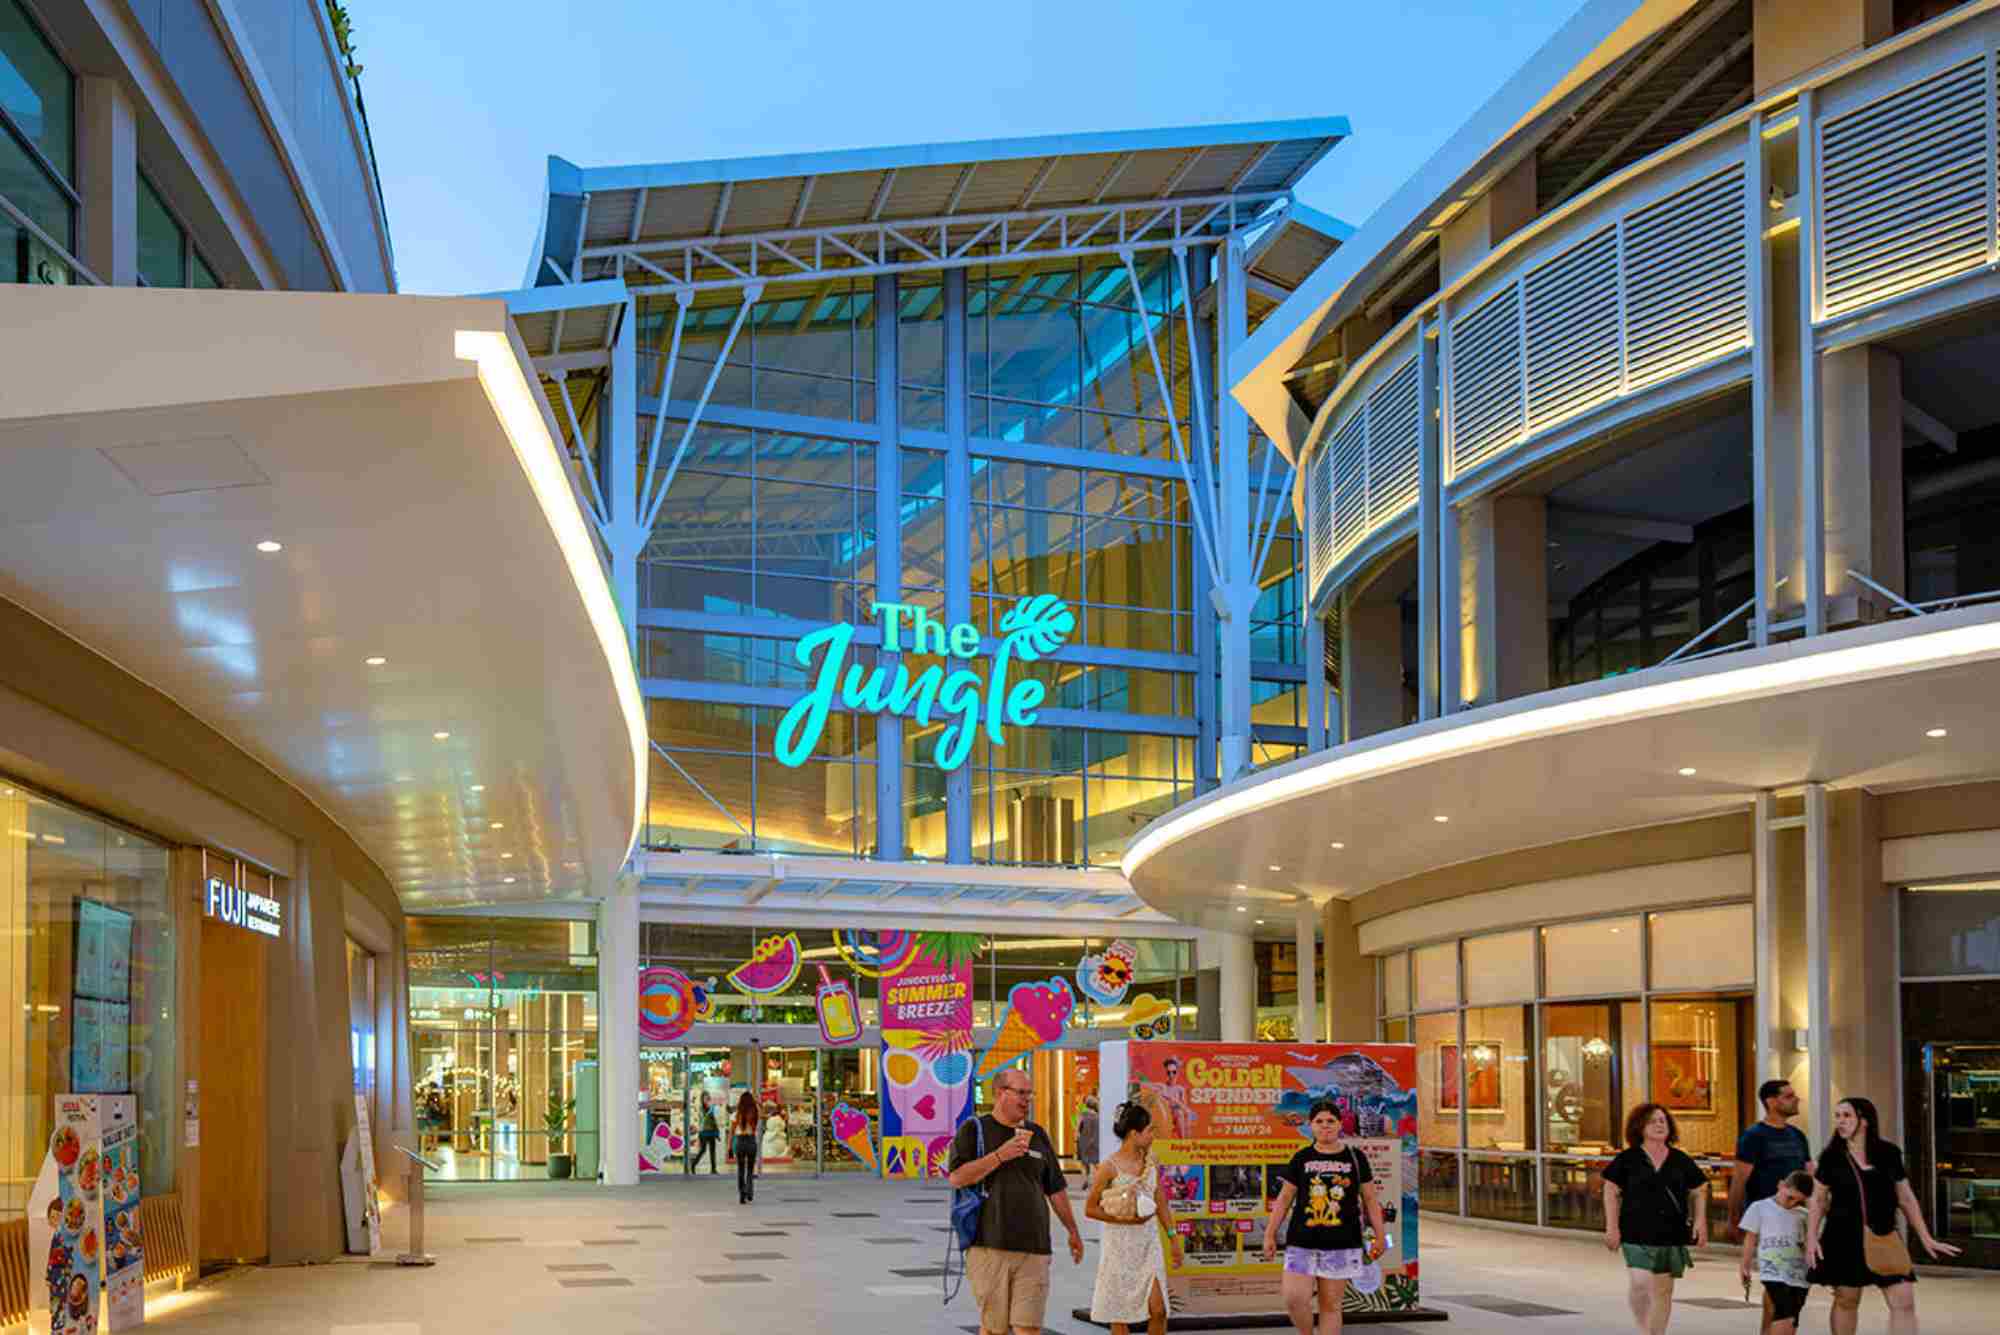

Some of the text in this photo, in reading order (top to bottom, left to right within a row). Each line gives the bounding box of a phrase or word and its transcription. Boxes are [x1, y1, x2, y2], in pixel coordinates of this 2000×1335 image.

[870, 601, 981, 659] The
[774, 620, 1046, 771] Jungle
[208, 880, 246, 927] FUJI
[887, 981, 966, 1005] SUMMER
[896, 1000, 956, 1020] BREEZE
[1185, 1057, 1283, 1088] GOLDEN
